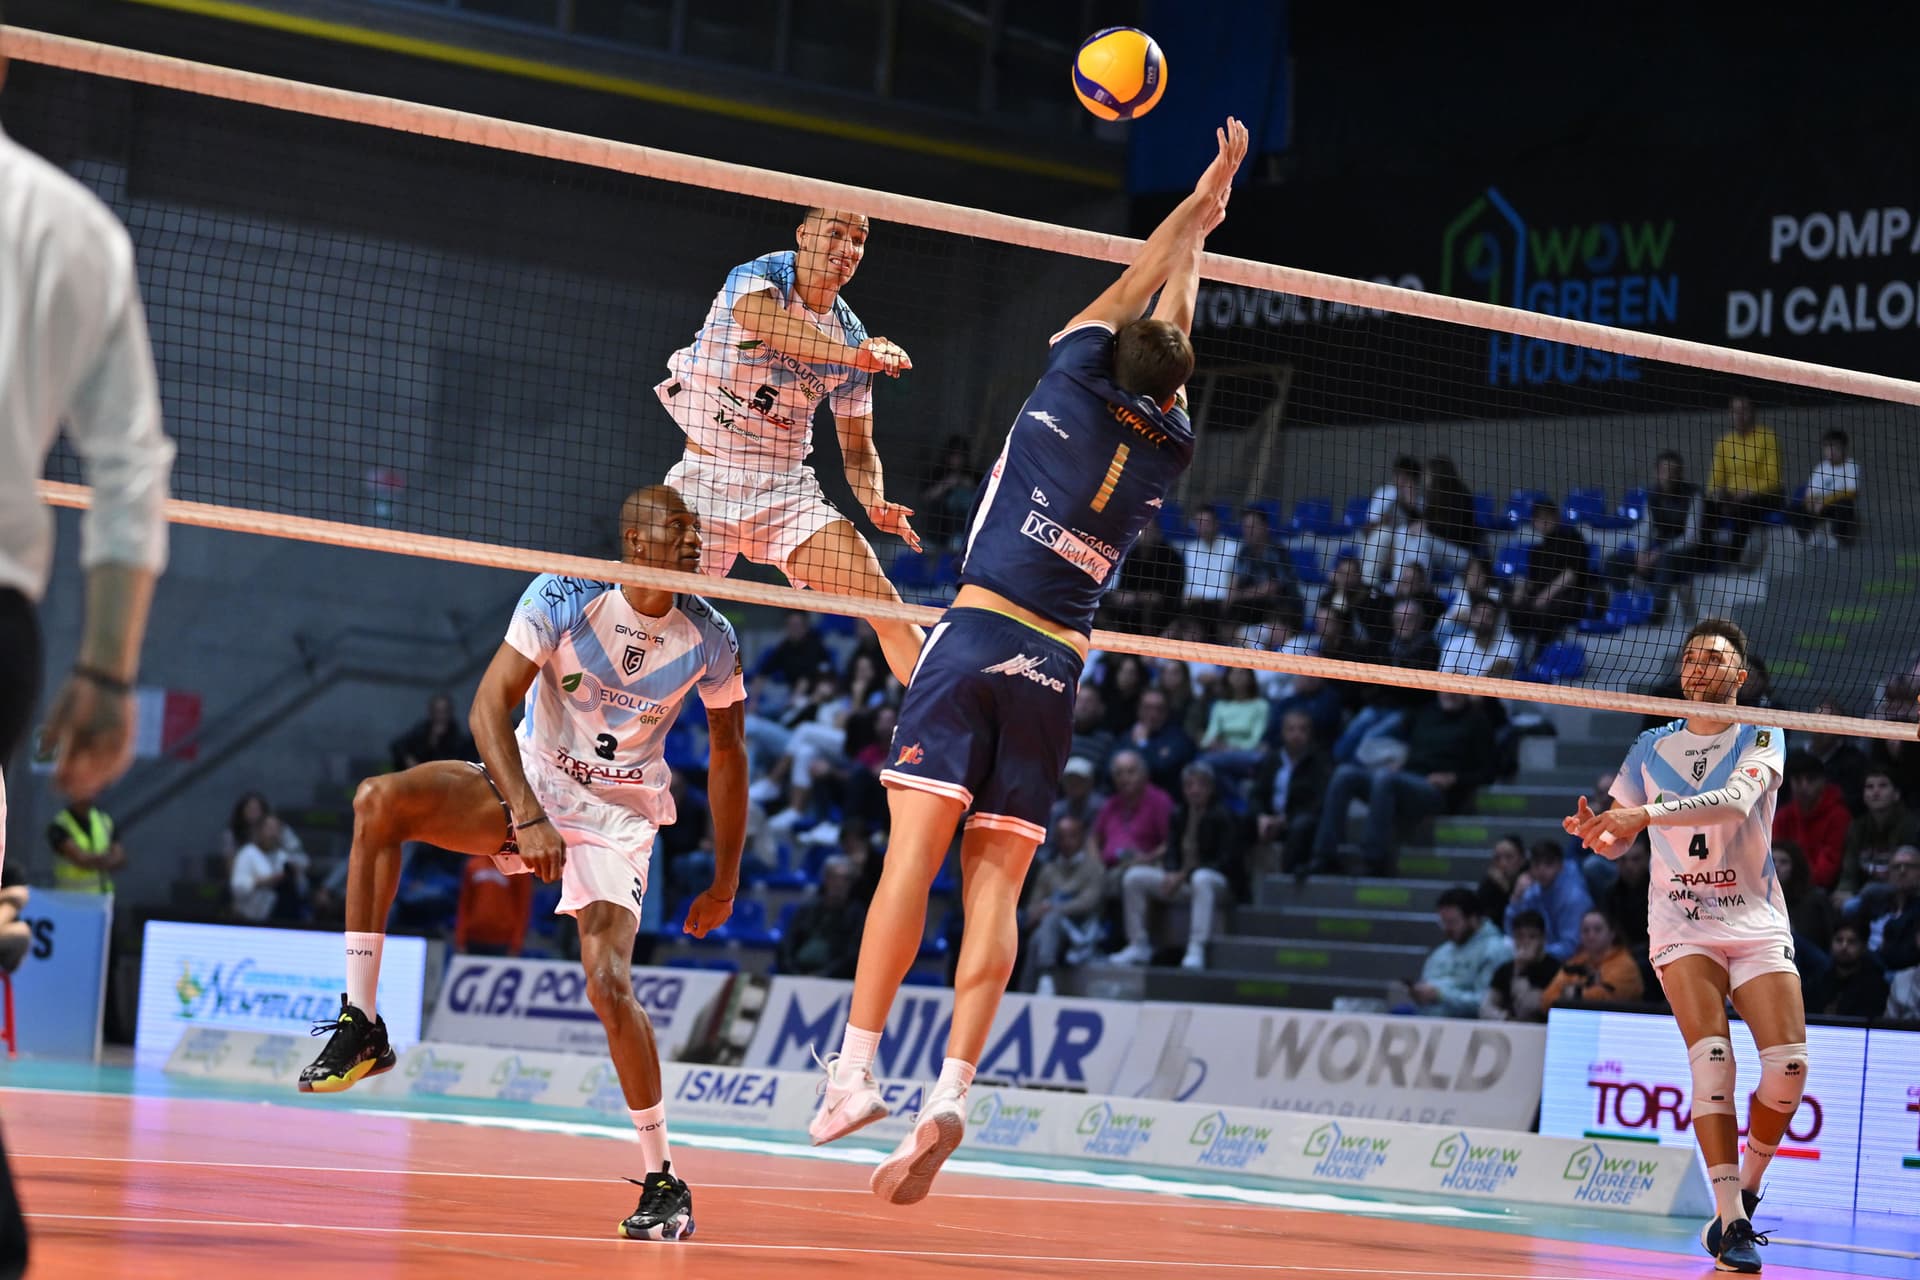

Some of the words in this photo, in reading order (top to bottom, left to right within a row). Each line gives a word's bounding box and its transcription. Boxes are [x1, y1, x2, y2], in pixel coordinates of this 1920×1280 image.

[1529, 219, 1675, 276] WOW
[1769, 206, 1920, 263] POMP
[1527, 273, 1680, 324] GREEN
[1726, 288, 1774, 339] DI
[1782, 279, 1920, 336] CALO
[772, 349, 826, 394] EVOLUTIO
[1488, 332, 1643, 386] HOUSE
[752, 384, 780, 415] 5
[1090, 442, 1131, 513] 1
[1022, 515, 1061, 547] DCS
[600, 689, 669, 715] EVOLUTIO
[594, 732, 618, 761] 3
[1688, 833, 1709, 860] 4
[448, 965, 525, 1017] G.B.
[1254, 1015, 1513, 1093] WORLD
[674, 1069, 780, 1108] ISMEA
[1225, 1124, 1273, 1141] WOW
[1341, 1135, 1392, 1152] WOW
[1461, 1158, 1519, 1179] GREEN
[1469, 1145, 1522, 1163] WOW
[1602, 1156, 1659, 1175] WOW
[1440, 1172, 1497, 1193] HOUSE
[1573, 1184, 1635, 1206] HOUSE
[1595, 1172, 1655, 1192] GREEN
